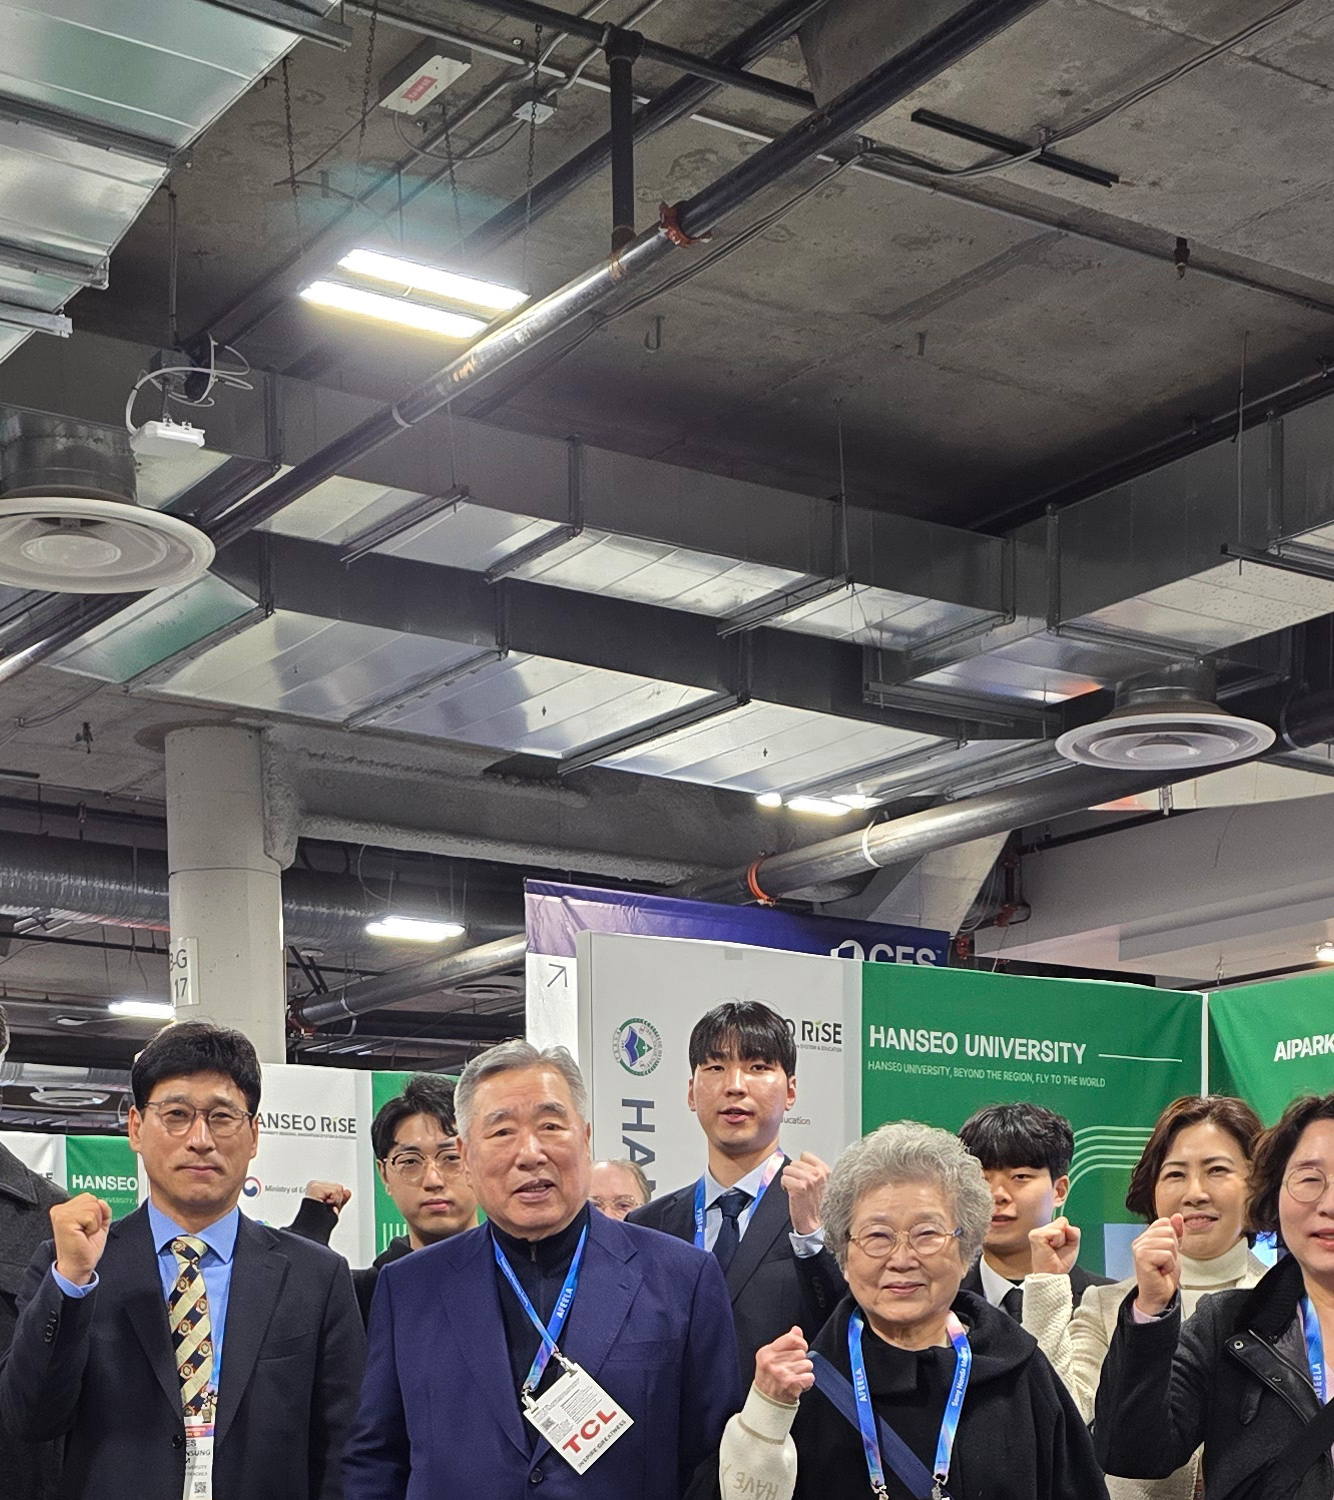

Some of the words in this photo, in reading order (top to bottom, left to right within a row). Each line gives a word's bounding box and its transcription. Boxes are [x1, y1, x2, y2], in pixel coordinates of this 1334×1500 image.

[869, 1024, 958, 1055] HANSEO
[965, 1033, 1087, 1064] UNIVERSITY
[867, 1060, 902, 1073] HANSEO
[903, 1063, 953, 1078] UNIVERSITY,
[953, 1066, 985, 1080] BEYOND
[986, 1069, 1002, 1081] THE
[1003, 1070, 1035, 1085] REGION,
[1035, 1073, 1050, 1084] FLY
[1051, 1073, 1062, 1085] TO
[1063, 1074, 1078, 1086] THE
[1078, 1076, 1106, 1088] WORLD
[72, 1174, 138, 1191] HANSEO
[556, 1287, 574, 1319] AFEELA
[562, 1408, 618, 1454] TCL
